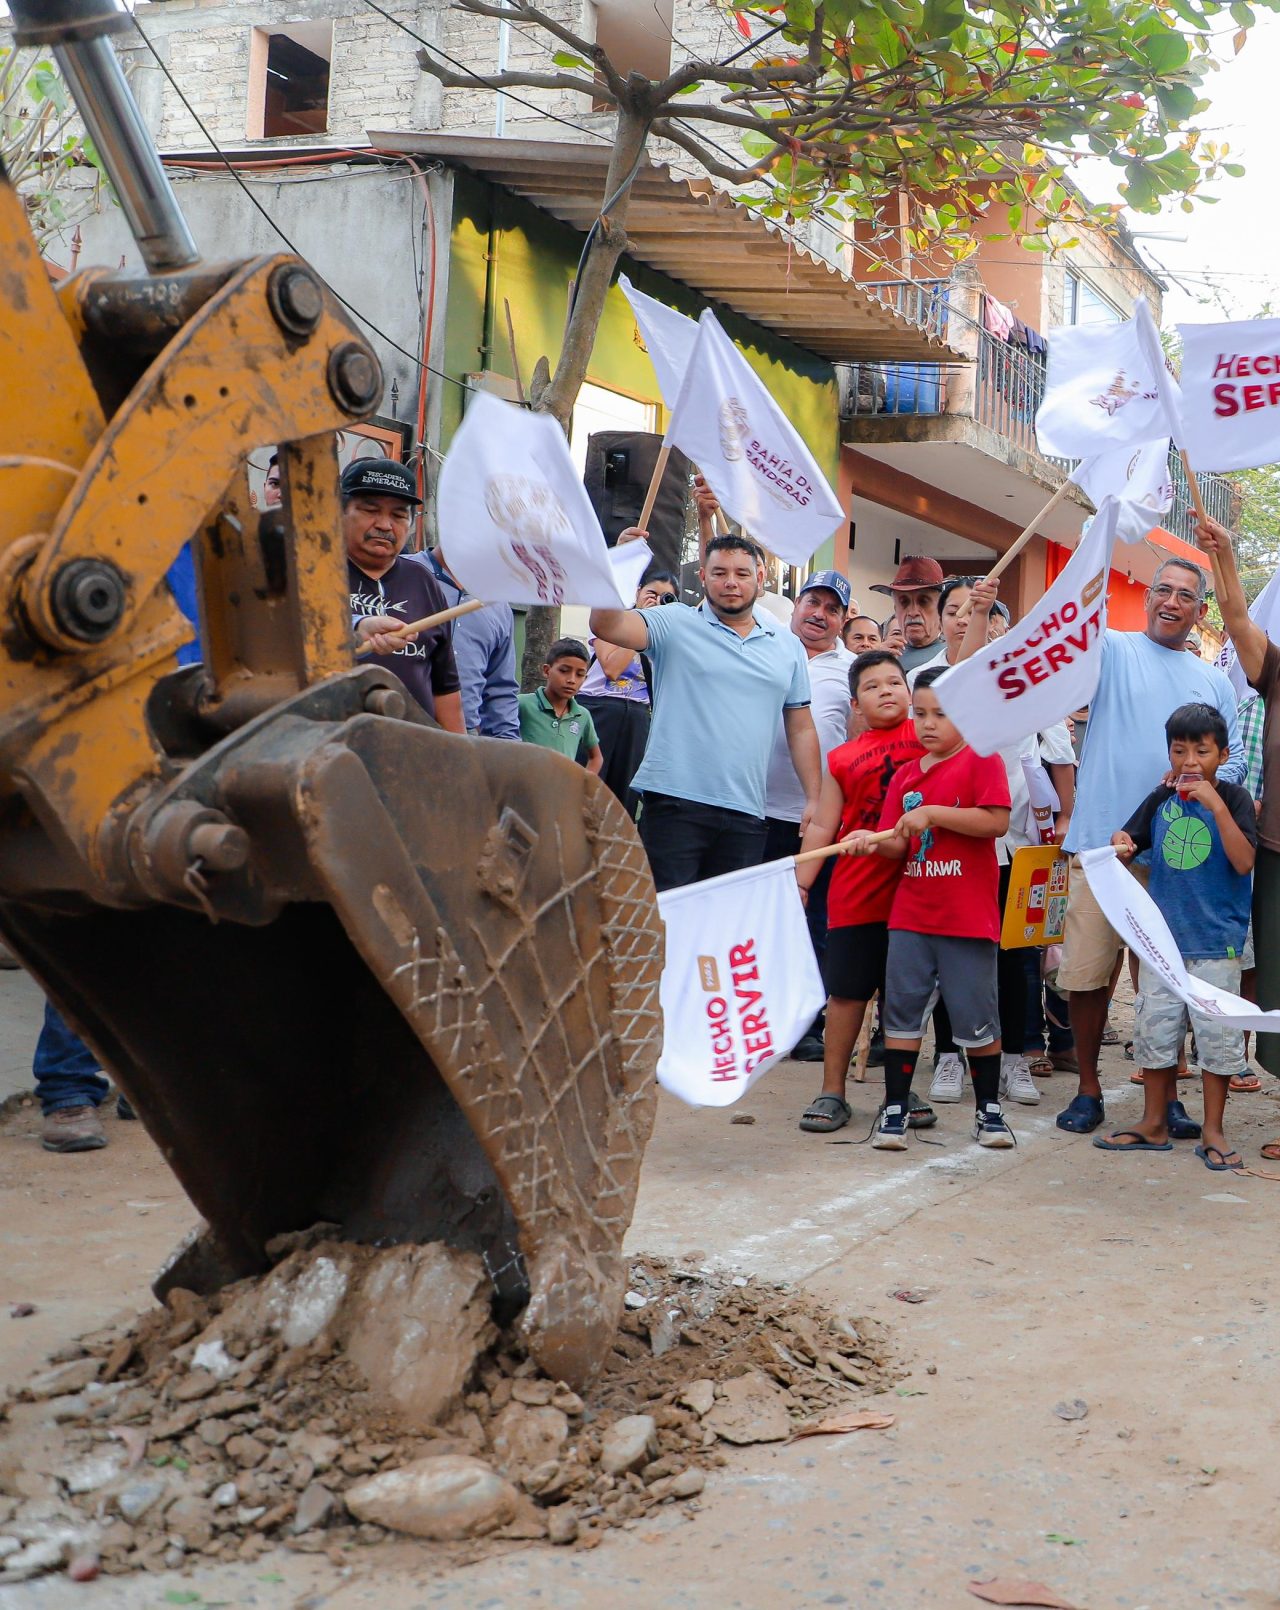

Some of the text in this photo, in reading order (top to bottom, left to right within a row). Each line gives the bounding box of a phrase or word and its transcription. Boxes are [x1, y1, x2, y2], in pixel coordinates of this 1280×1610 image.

[750, 440, 794, 479] BAHÍA
[926, 859, 962, 877] RAWR
[710, 996, 738, 1082] HECHO
